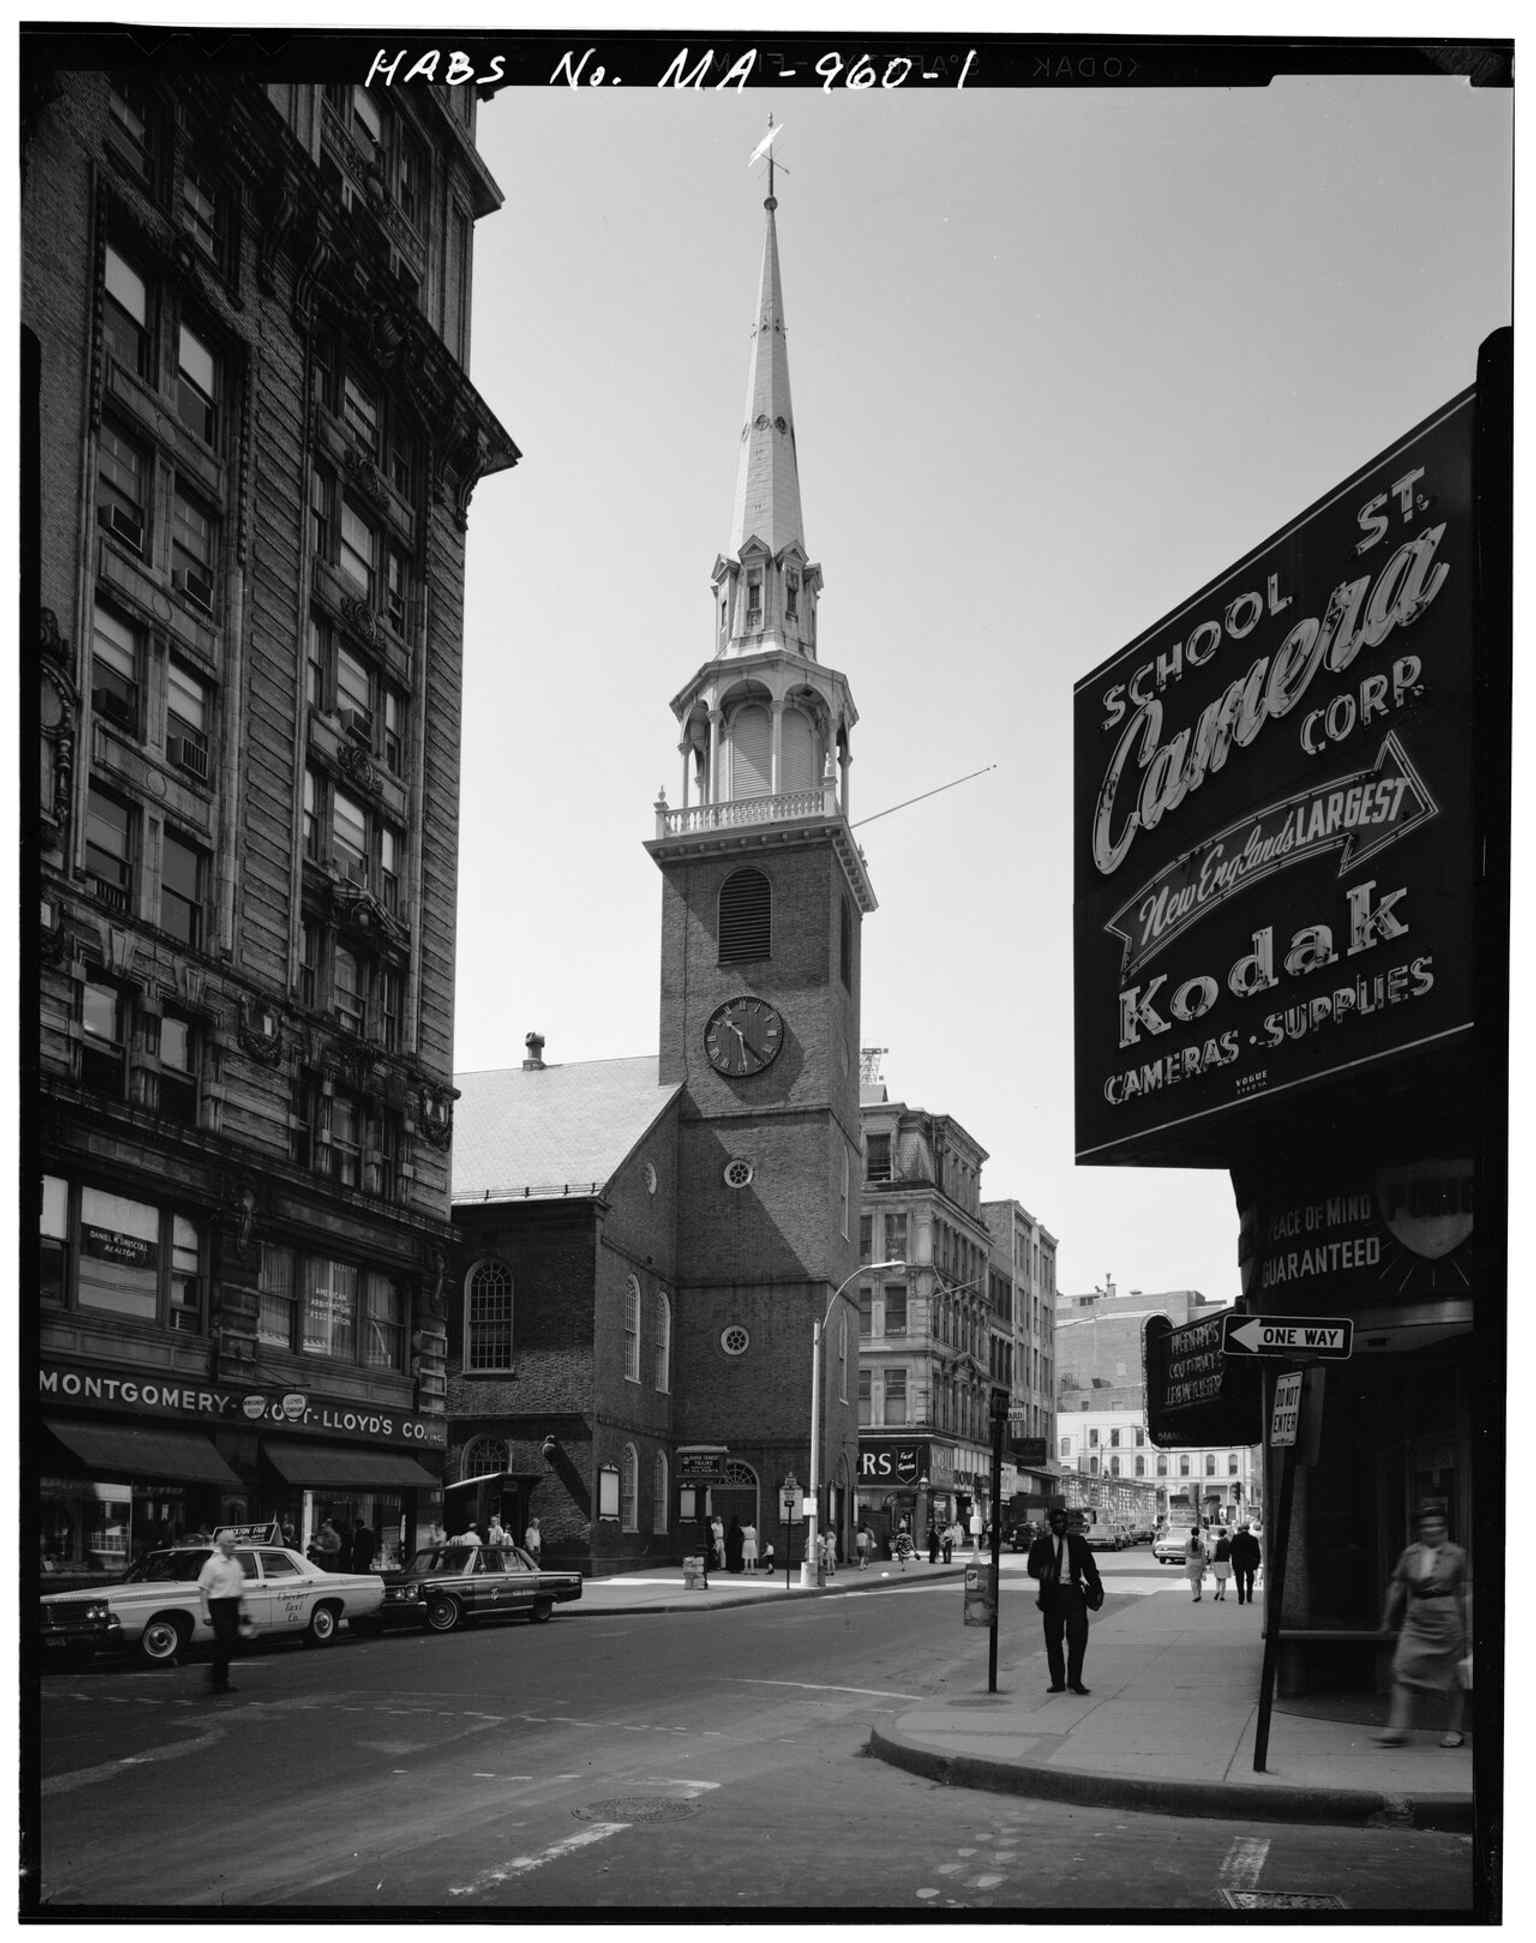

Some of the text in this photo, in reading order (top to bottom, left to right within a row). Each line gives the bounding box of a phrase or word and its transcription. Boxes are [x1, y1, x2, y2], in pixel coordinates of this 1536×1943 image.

[1101, 466, 1430, 730] SCHOOL ST.
[1092, 522, 1451, 875] Camera
[1299, 655, 1425, 756] CORP.
[1139, 884, 1198, 946] New
[1295, 777, 1410, 847] LARGEST
[1119, 880, 1409, 1048] Kodak
[1104, 956, 1436, 1106] CAMERAS SUPPLIES
[1235, 1070, 1268, 1087] VOGUE
[1269, 1193, 1370, 1241] EACE OF MIND
[104, 1244, 136, 1259] REALTOR
[1262, 1236, 1380, 1288] GUARANTEED
[1263, 1329, 1339, 1346] ONE WAY
[1275, 1385, 1299, 1408] DO NOT
[1273, 1412, 1297, 1433] ENTER
[857, 1453, 892, 1476] RS
